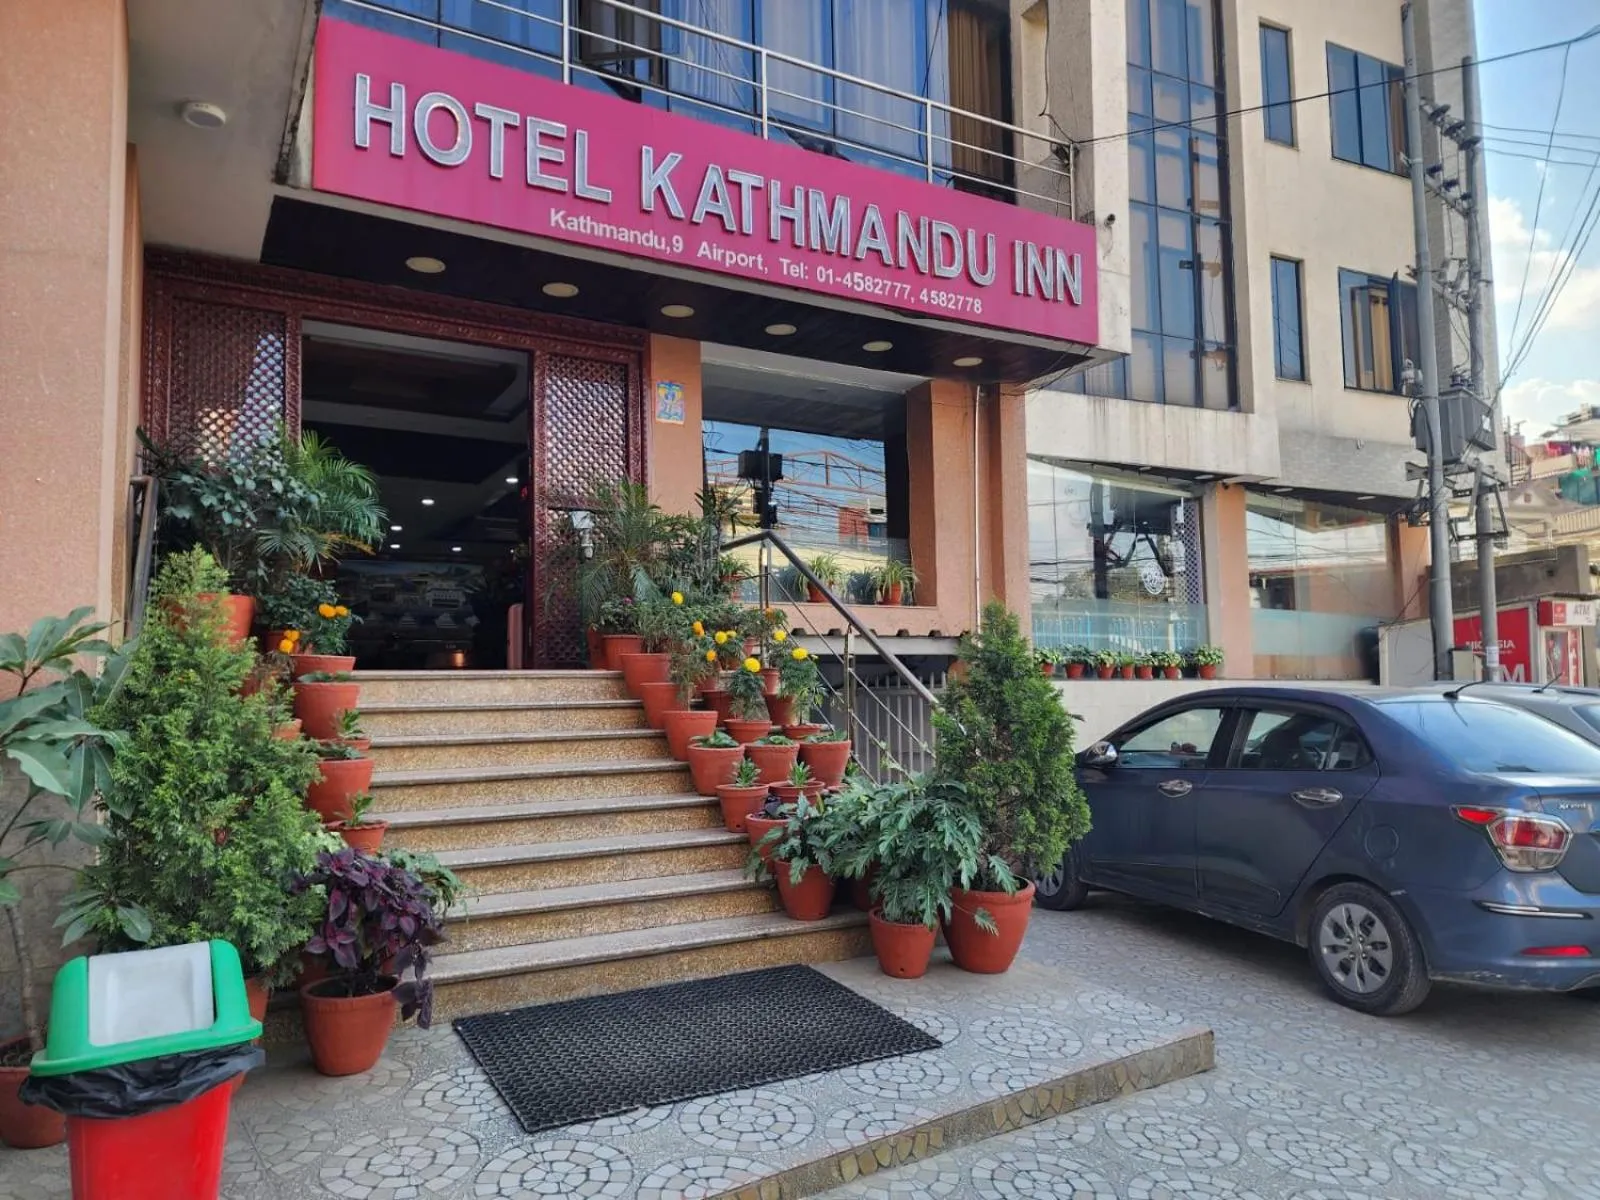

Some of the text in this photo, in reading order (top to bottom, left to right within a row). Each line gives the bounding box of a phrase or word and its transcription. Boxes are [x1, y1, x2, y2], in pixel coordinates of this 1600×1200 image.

[355, 73, 1082, 305] HOTEL KATHMANDU INN
[697, 241, 769, 274] Airport,
[779, 257, 809, 280] Tel:
[816, 266, 916, 303] 01-4582777,
[919, 287, 983, 314] 4582778
